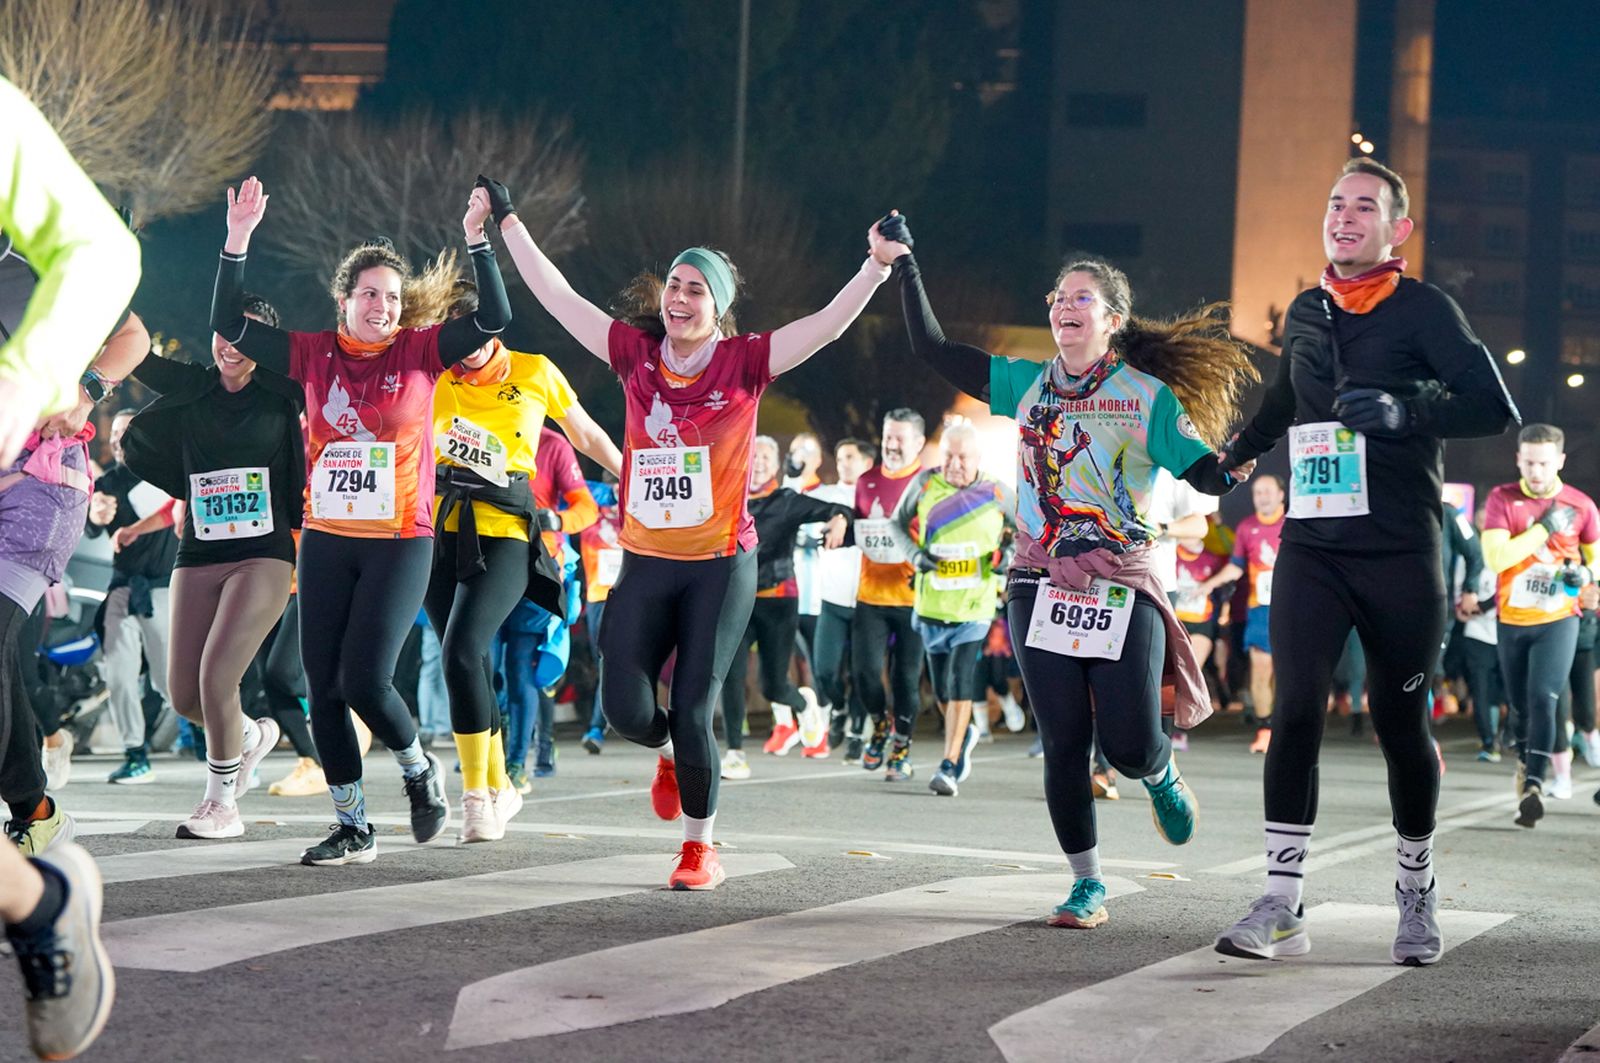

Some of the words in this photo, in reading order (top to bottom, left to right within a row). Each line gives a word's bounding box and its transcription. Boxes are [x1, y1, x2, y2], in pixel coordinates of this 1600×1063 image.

[1060, 399, 1095, 413] SIERRA
[1098, 398, 1141, 412] MORENA
[335, 413, 358, 434] 43
[1066, 412, 1096, 420] MONTES
[1097, 413, 1142, 421] COMUNALES
[472, 431, 481, 439] DE
[656, 428, 677, 448] 43
[329, 450, 352, 458] NOCHE
[352, 450, 362, 458] DE
[447, 438, 492, 467] 2245
[322, 459, 337, 468] SAN
[646, 456, 667, 466] NOCHE
[667, 456, 677, 464] DE
[639, 468, 651, 476] SAN
[230, 476, 239, 484] DE
[327, 469, 377, 493] 7294
[644, 475, 693, 501] 7349
[203, 492, 259, 517] 13132
[940, 559, 969, 574] 5917
[1047, 589, 1066, 601] SAN
[1088, 586, 1100, 595] DE
[1525, 579, 1557, 597] 1850
[1050, 602, 1113, 631] 6935
